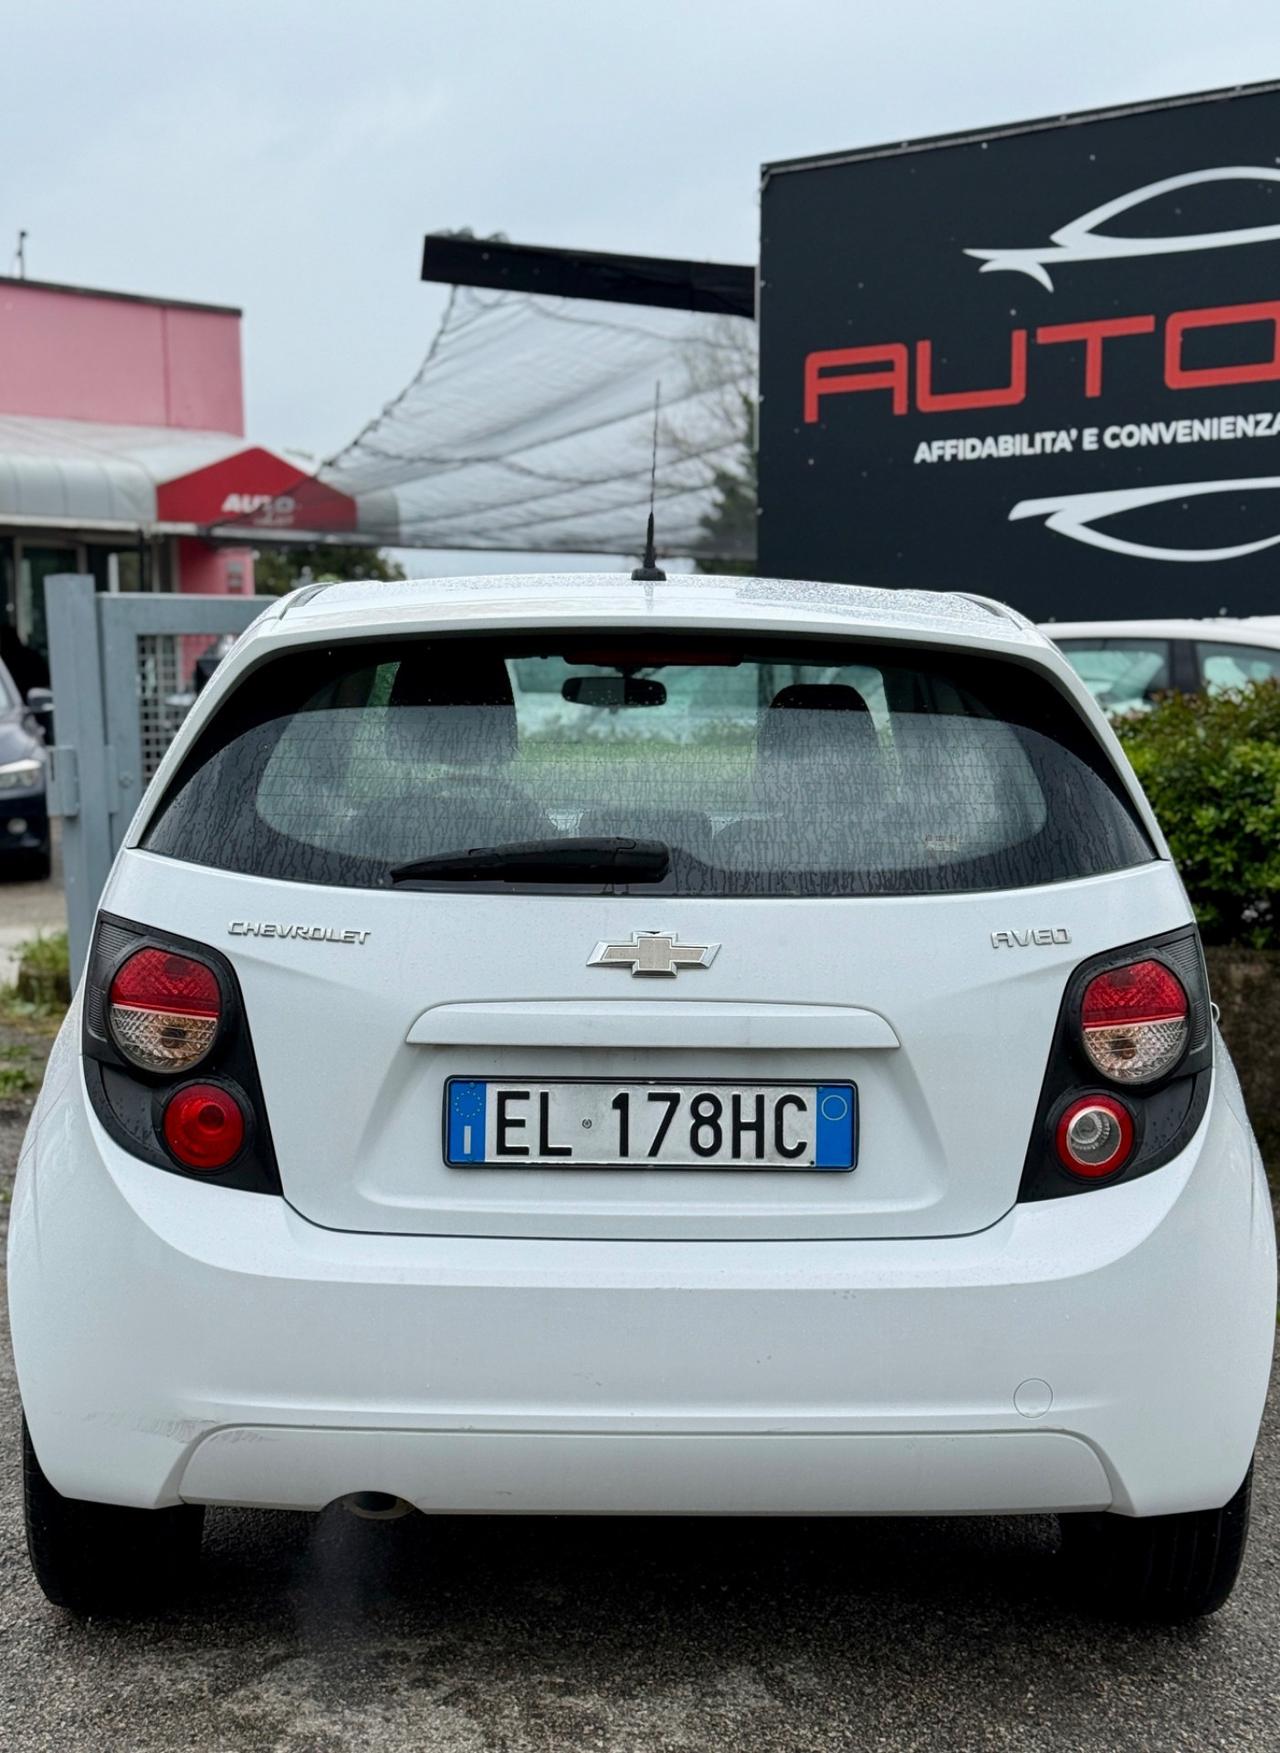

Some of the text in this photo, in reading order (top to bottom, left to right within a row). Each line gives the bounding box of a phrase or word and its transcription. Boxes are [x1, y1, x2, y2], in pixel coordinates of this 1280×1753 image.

[804, 301, 1280, 423] AUTO
[914, 429, 1077, 463] AFFIDABILITA'
[1082, 427, 1099, 450] E
[228, 920, 371, 945] CHEVROLET
[990, 928, 1072, 948] AVEO
[496, 1090, 808, 1159] EL 178HC
